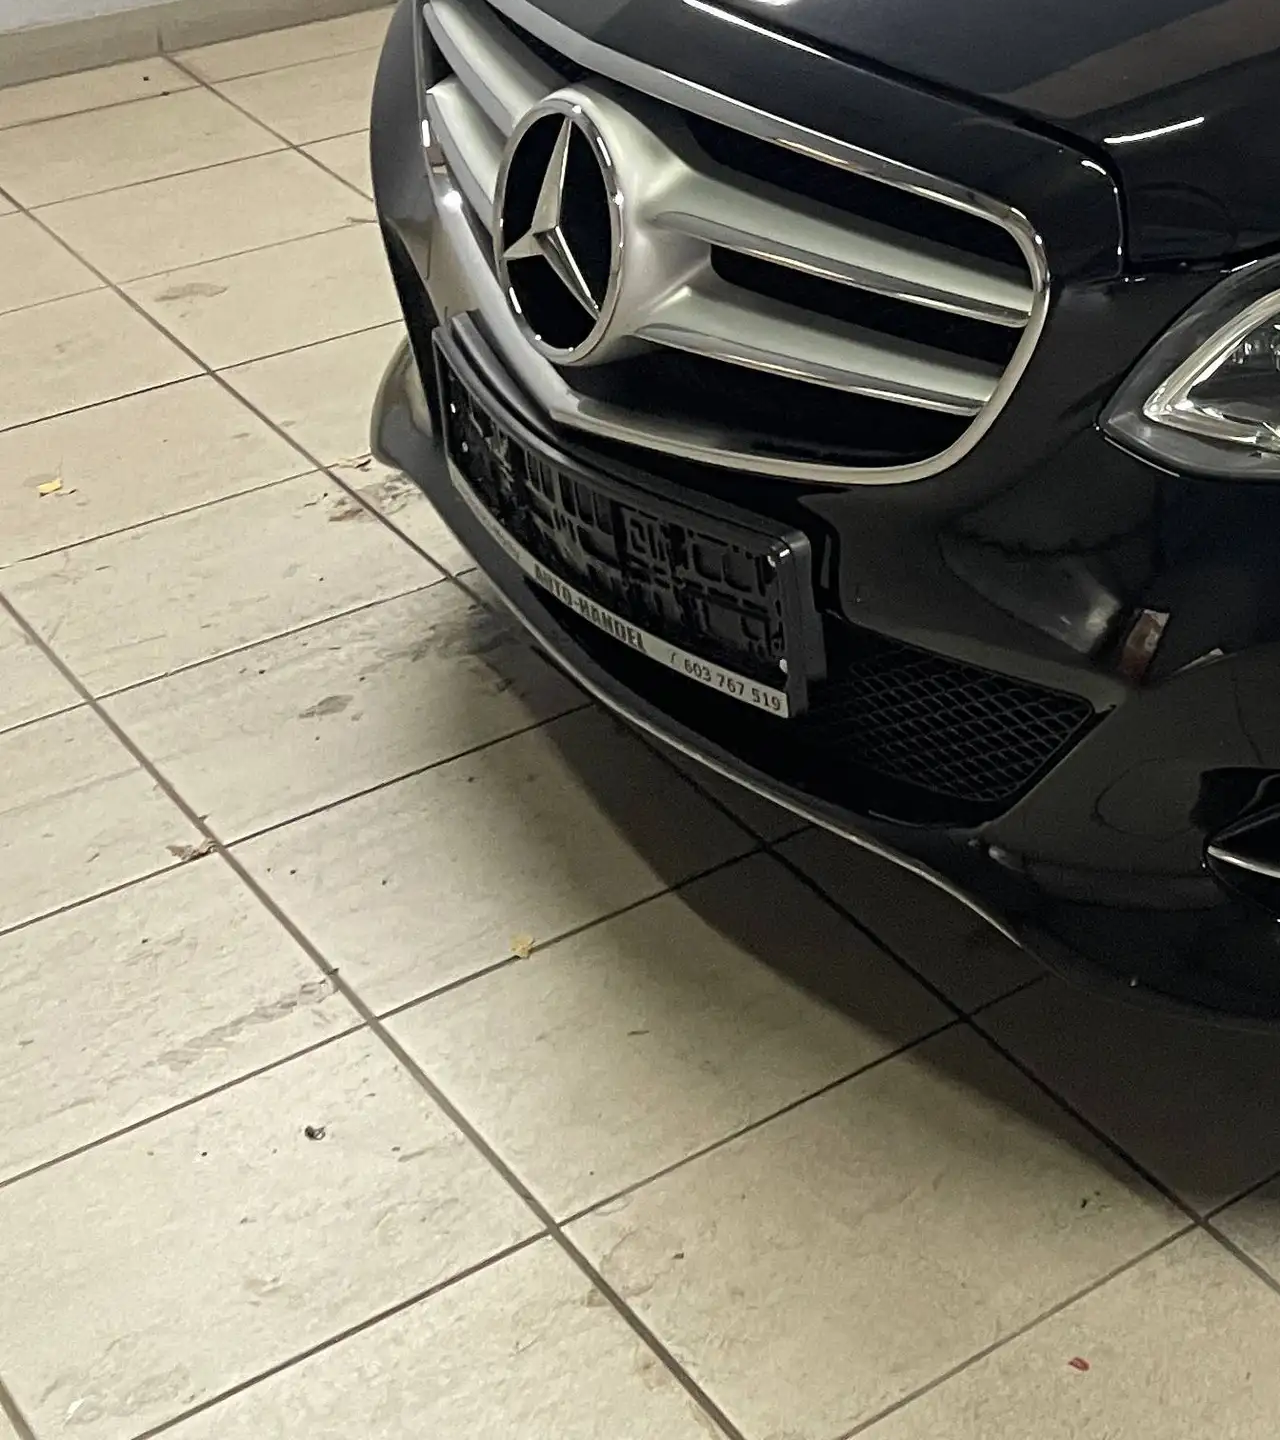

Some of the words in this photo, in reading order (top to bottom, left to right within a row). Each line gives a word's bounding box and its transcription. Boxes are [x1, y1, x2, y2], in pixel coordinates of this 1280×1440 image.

[684, 659, 712, 682] 603
[717, 673, 744, 696] 767
[752, 687, 781, 711] 519
